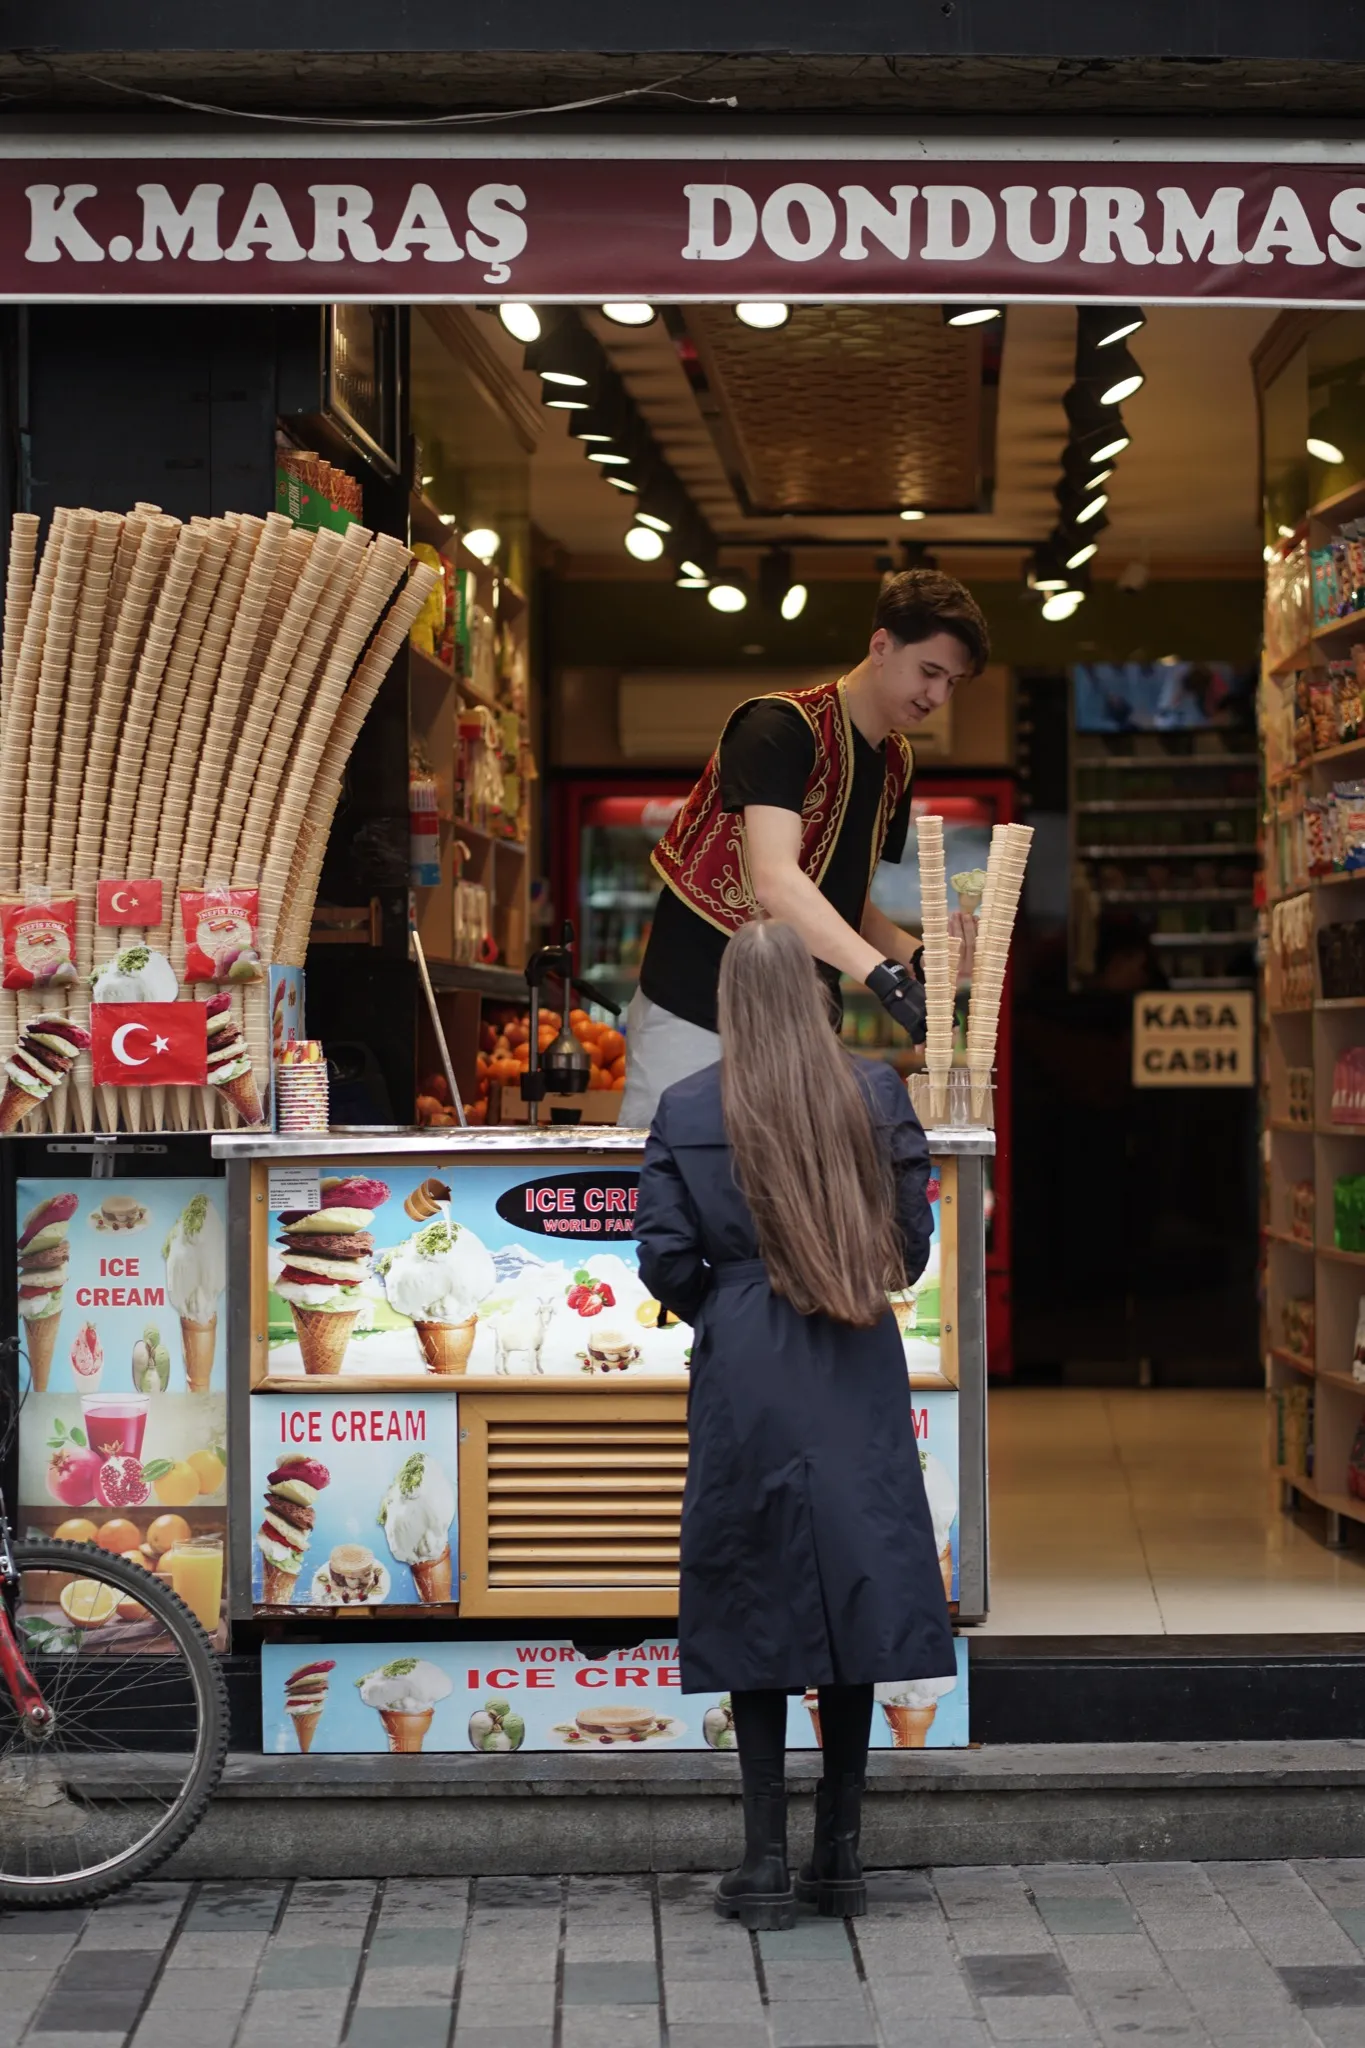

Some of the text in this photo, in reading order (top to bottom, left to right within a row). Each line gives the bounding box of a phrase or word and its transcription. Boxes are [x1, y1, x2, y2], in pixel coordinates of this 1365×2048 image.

[24, 182, 1365, 284] K.MARAŞ DONDURMAS
[1143, 1004, 1238, 1030] KASA
[1143, 1048, 1238, 1073] CASH
[525, 1188, 576, 1213] ICE
[543, 1218, 601, 1232] WORLD
[100, 1258, 140, 1277] ICE
[76, 1287, 165, 1307] CREAM
[280, 1410, 426, 1443] ICE CREAM
[467, 1668, 556, 1689] ICE
